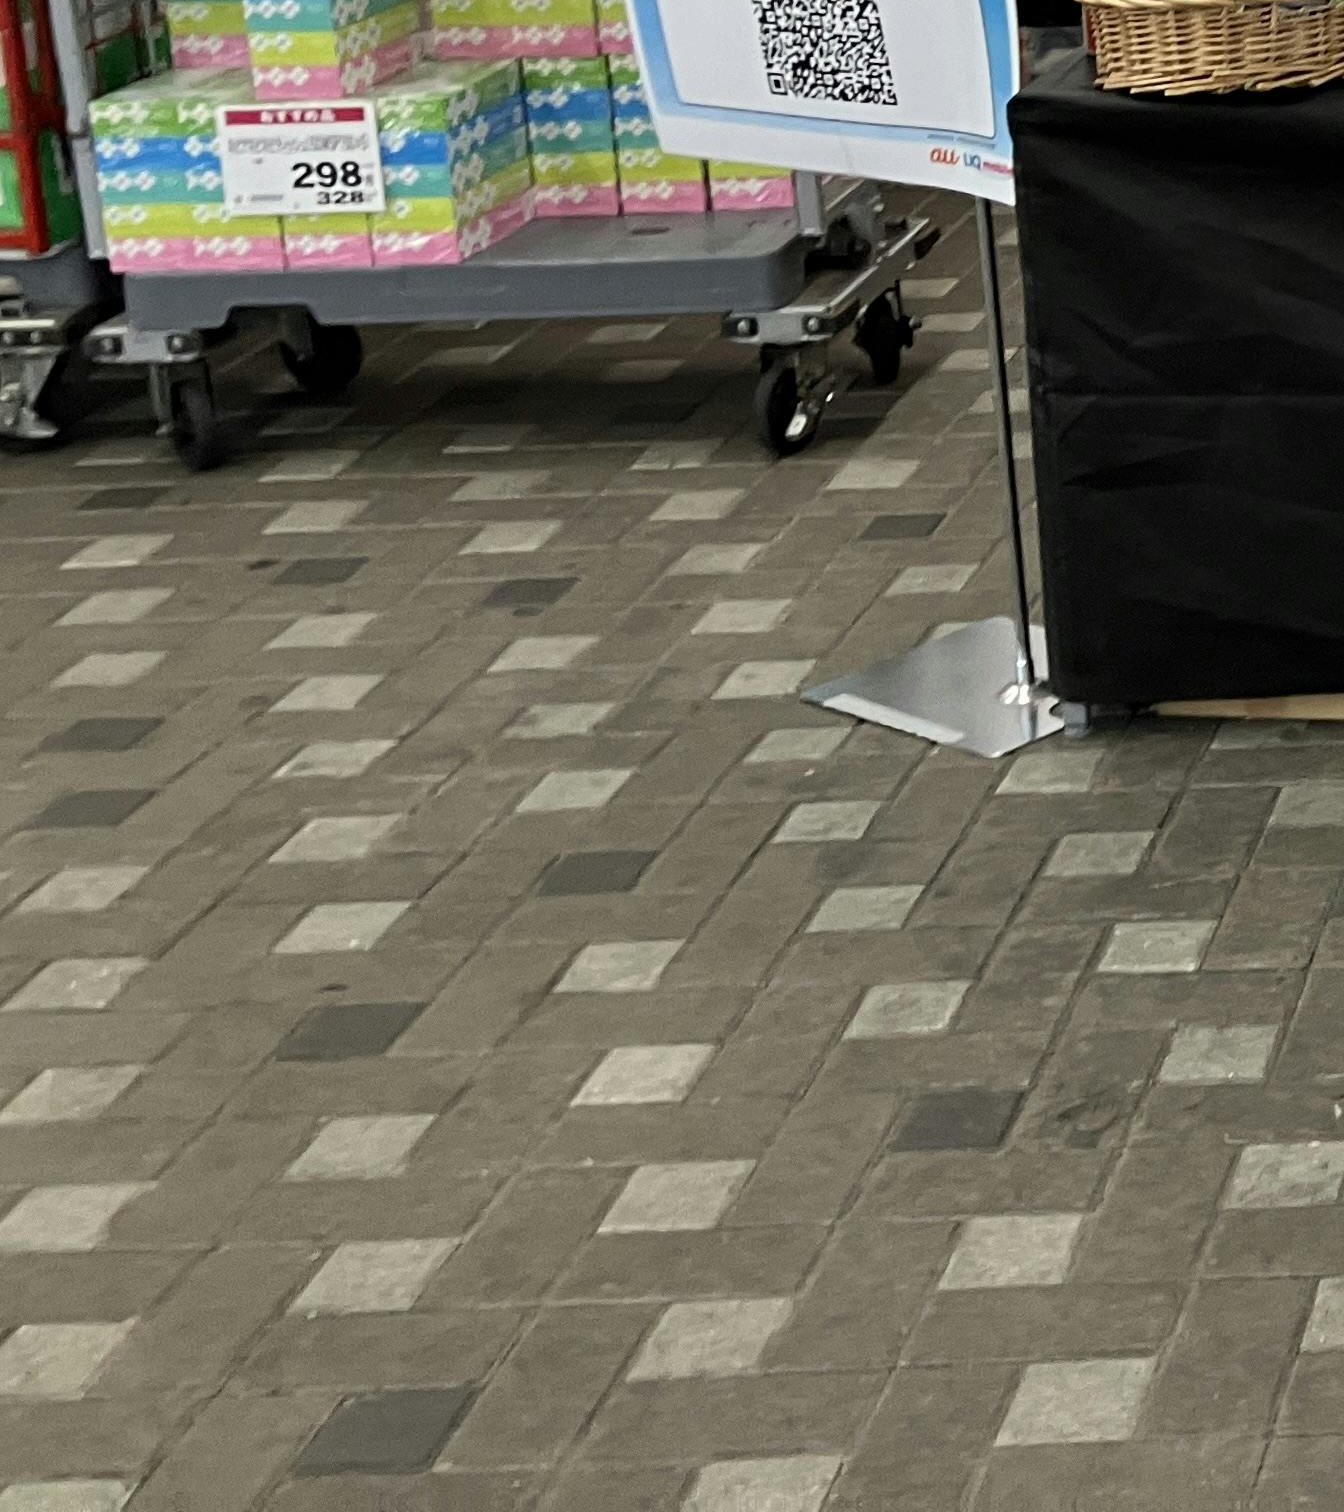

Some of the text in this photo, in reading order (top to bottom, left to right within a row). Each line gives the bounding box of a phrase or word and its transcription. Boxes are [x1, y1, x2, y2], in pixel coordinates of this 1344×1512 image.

[930, 147, 961, 166] au
[292, 160, 363, 189] 298
[316, 190, 364, 206] 328
